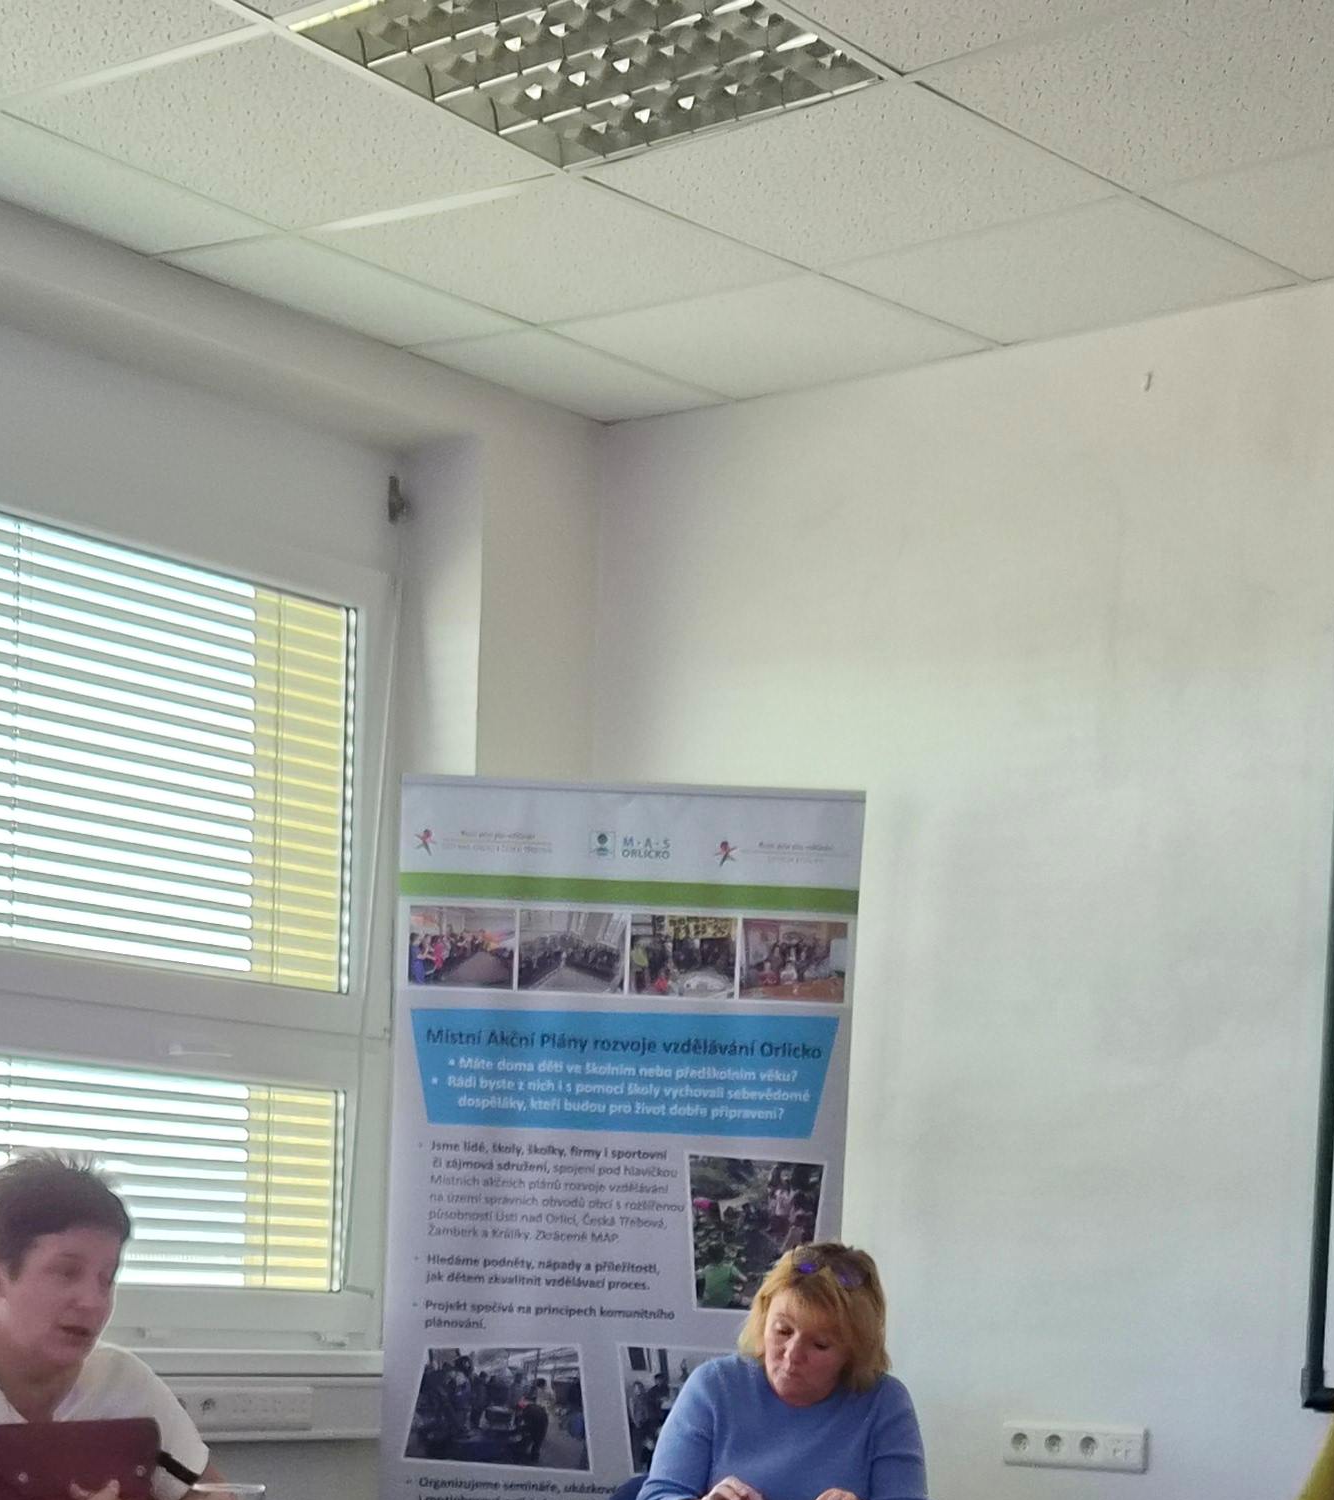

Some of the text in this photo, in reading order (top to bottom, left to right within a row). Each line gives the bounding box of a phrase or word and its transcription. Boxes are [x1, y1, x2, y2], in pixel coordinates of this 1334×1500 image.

[621, 848, 671, 860] ORLICKO
[426, 1027, 823, 1060] Místní Akční Plány rozvoje vzdělávání Orlicko
[458, 1057, 799, 1083] Máte doma děti ve školním nebo předškolním věku?
[447, 1075, 477, 1089] Rádi
[479, 1076, 516, 1092] byste
[527, 1078, 555, 1093] nich
[575, 1080, 625, 1095] pomocí
[627, 1082, 660, 1099] školy
[663, 1083, 725, 1100] vychovali
[727, 1086, 811, 1102] sebevědomé
[530, 1096, 561, 1111] kteří
[563, 1098, 607, 1113] budou
[609, 1103, 632, 1117] pro
[634, 1102, 667, 1117] život
[669, 1102, 708, 1118] dobře
[430, 1140, 461, 1152] Jsme
[570, 1145, 602, 1160] firmy
[611, 1148, 668, 1160] sportovní
[446, 1159, 494, 1171] zájmová
[598, 1165, 621, 1177] pod
[623, 1165, 679, 1178] hlavičkou
[427, 1253, 480, 1266] Hledáme
[538, 1259, 582, 1273] nápady
[425, 1269, 444, 1284] jak
[447, 1271, 486, 1284] dětem
[545, 1276, 606, 1289] vzdělávací
[424, 1299, 676, 1321] Projekt spočívá na principech komunitního
